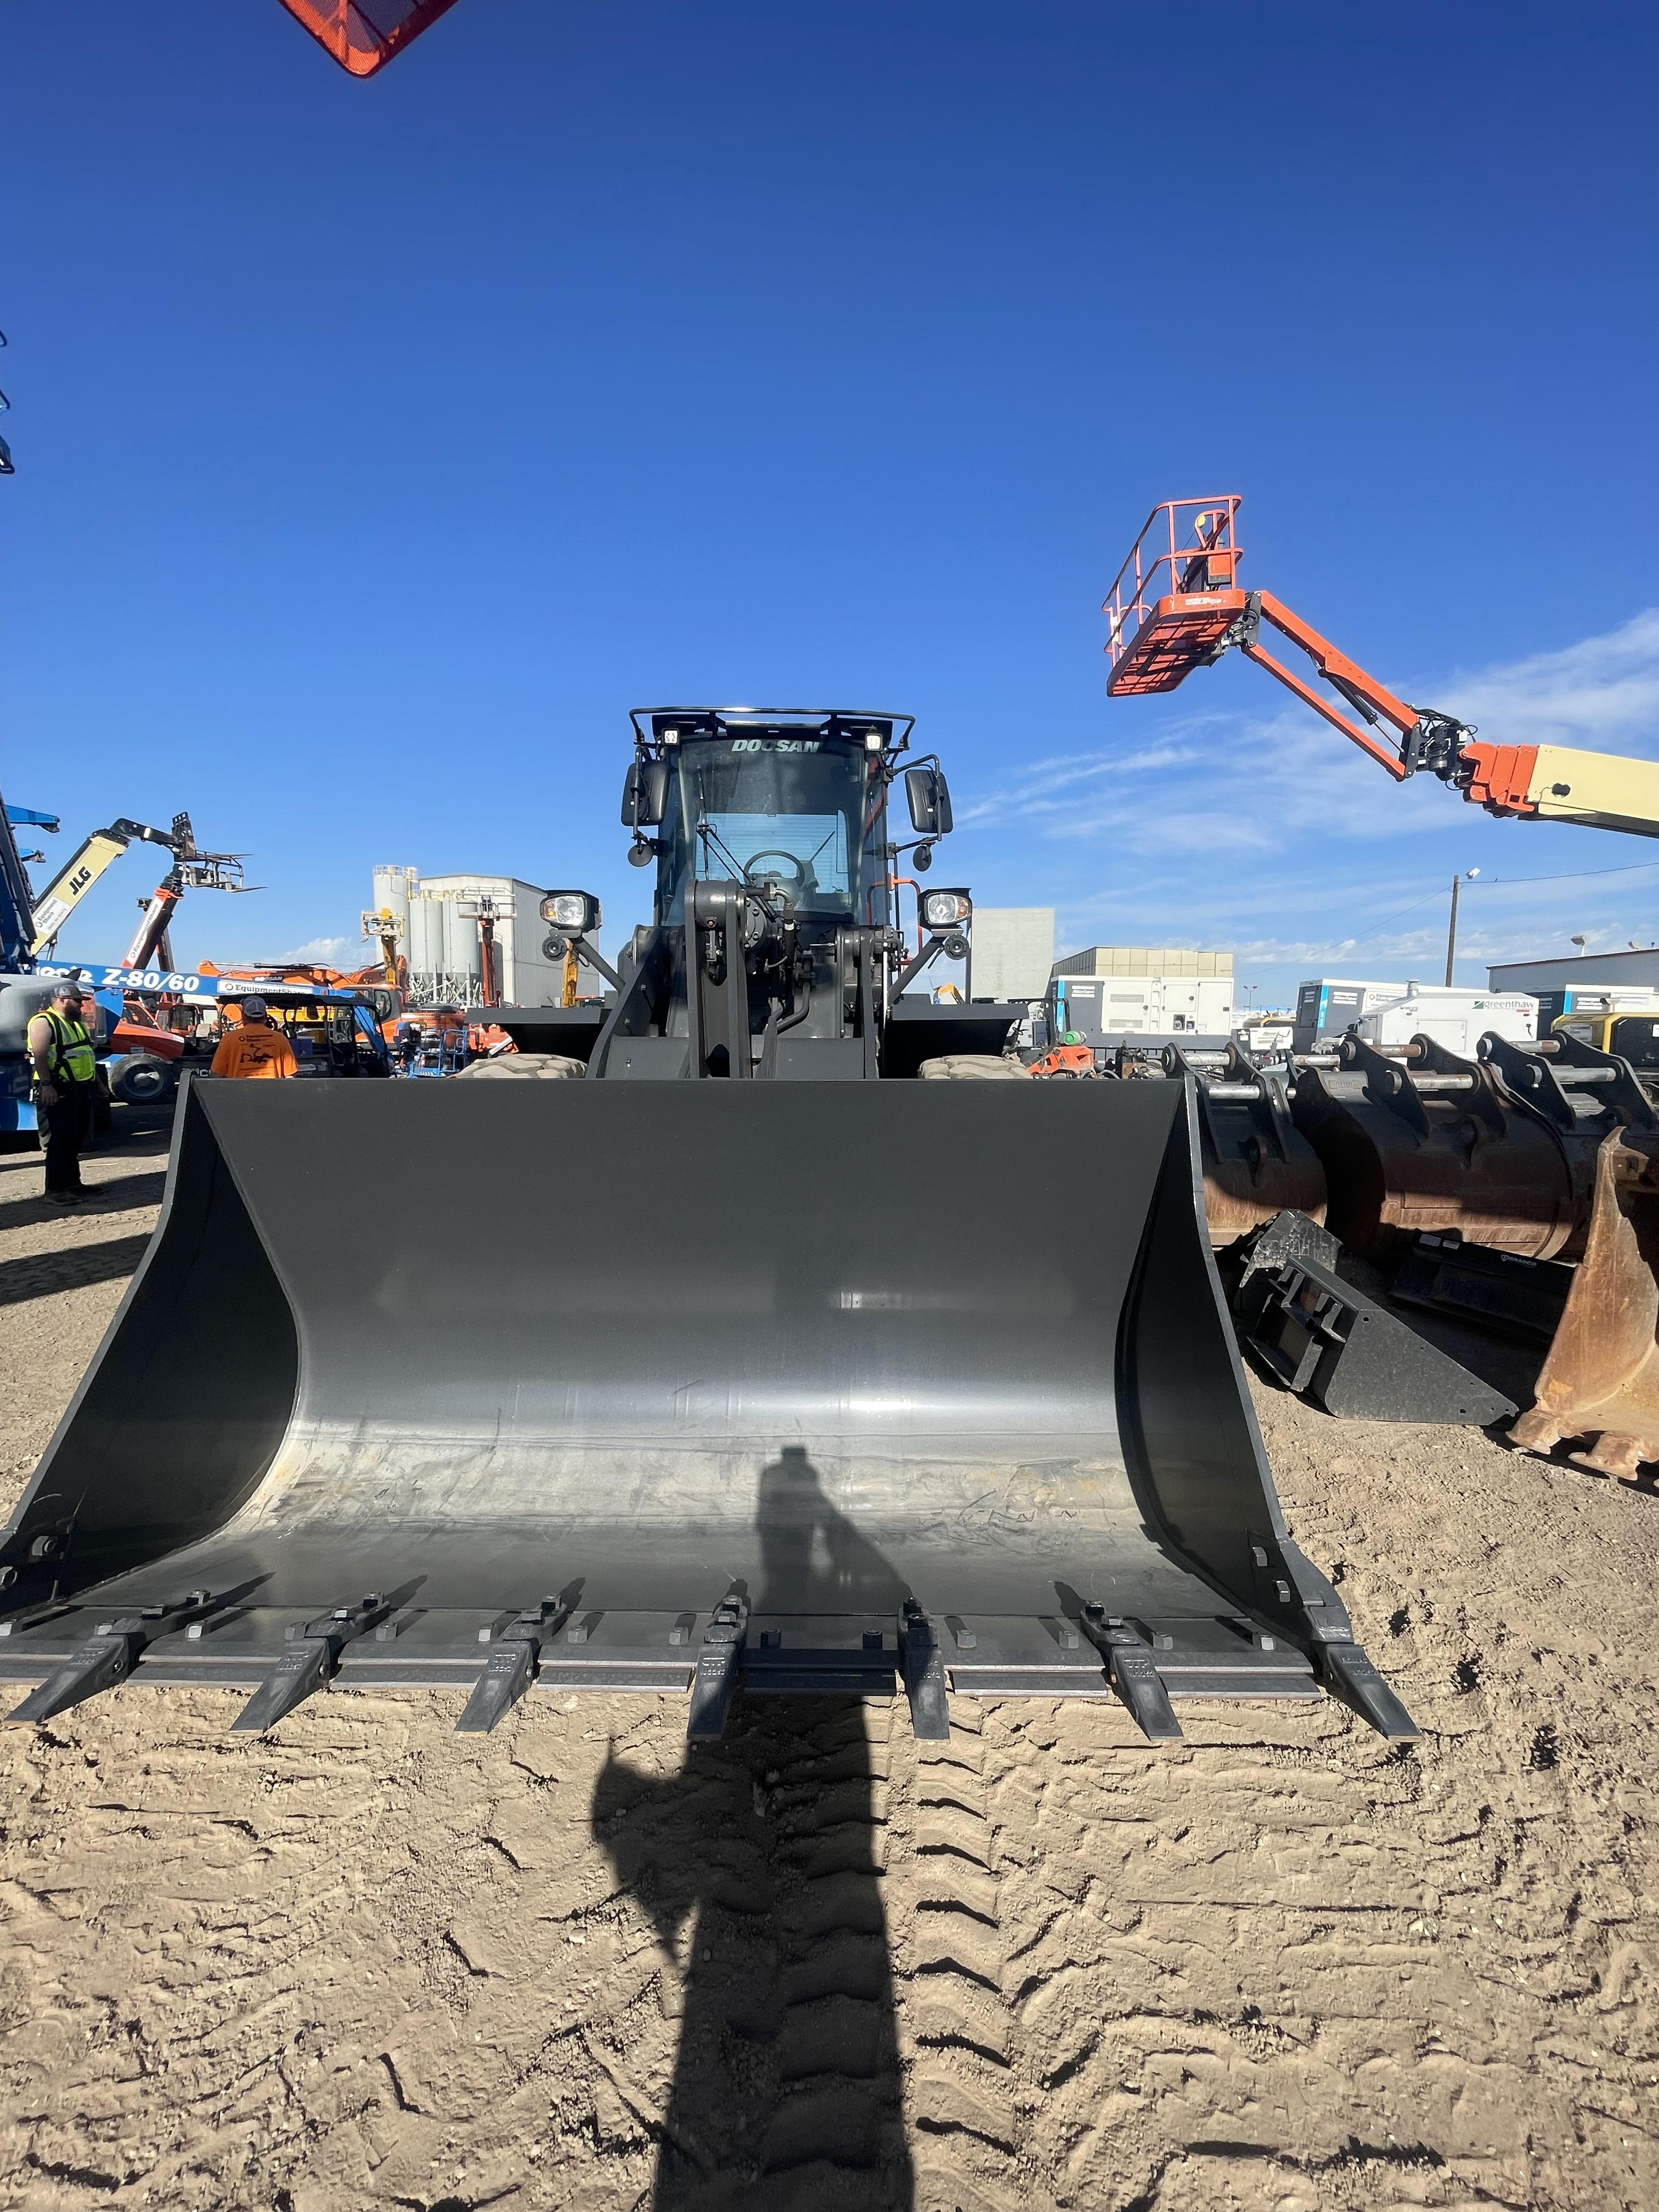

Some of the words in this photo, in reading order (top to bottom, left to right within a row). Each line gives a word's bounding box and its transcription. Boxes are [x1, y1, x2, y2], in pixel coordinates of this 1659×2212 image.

[731, 739, 820, 753] DOOSAN
[69, 866, 92, 896] JLG
[133, 904, 158, 952] EquipmentShare
[101, 968, 199, 992] Z-80/60
